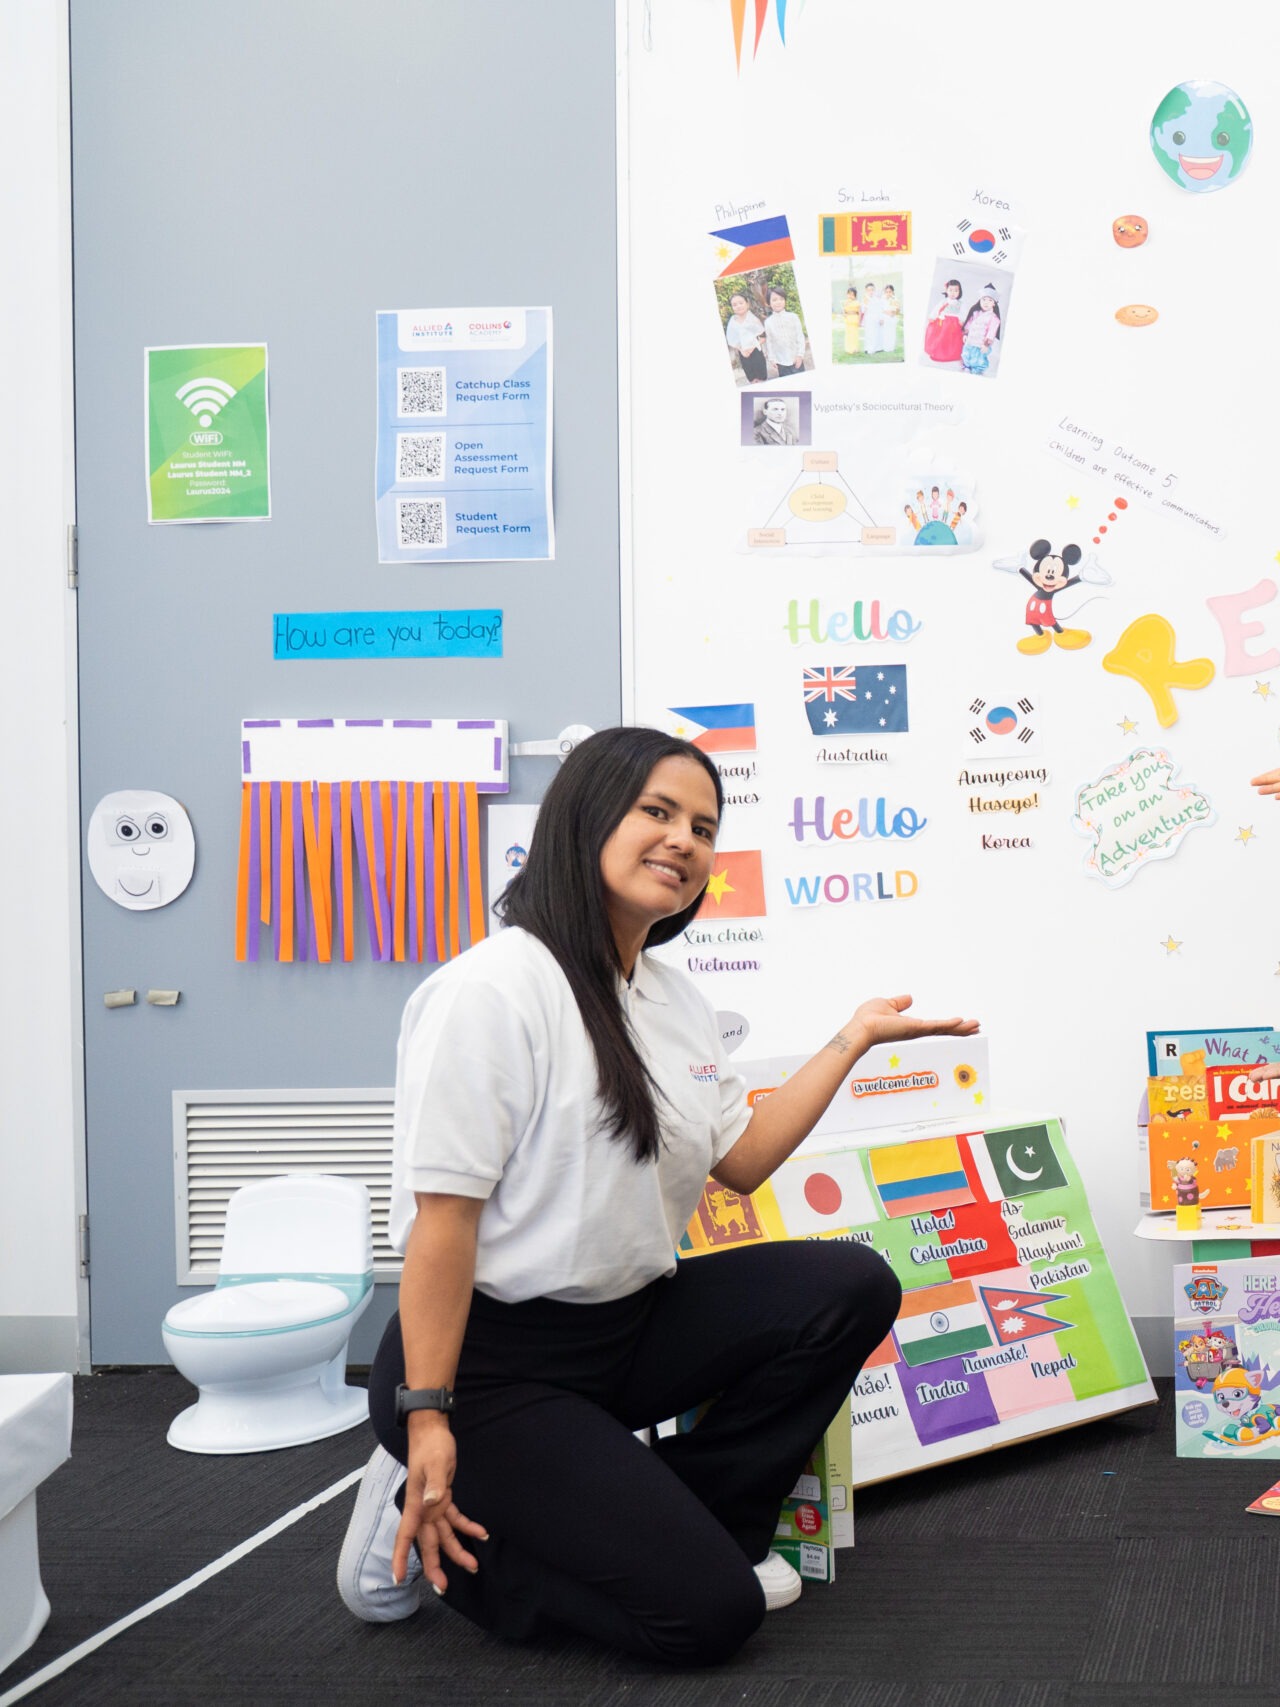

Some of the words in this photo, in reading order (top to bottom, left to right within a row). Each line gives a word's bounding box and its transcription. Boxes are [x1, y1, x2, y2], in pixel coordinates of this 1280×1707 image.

[838, 188, 856, 203] Sri
[861, 189, 891, 202] Lanka
[972, 189, 1011, 211] Korea
[413, 323, 443, 332] ALLIED
[468, 322, 502, 330] COLLINS
[455, 380, 500, 392] Catchup
[503, 378, 531, 388] Class
[456, 393, 499, 404] Request
[502, 391, 530, 400] Form
[814, 403, 860, 414] Vygotsky's
[862, 402, 922, 411] Sociocultural
[924, 402, 954, 412] Theory
[182, 450, 211, 459] Student
[454, 441, 483, 453] Open
[1058, 416, 1104, 451] Learning
[1113, 446, 1156, 475] Outcome
[1161, 473, 1178, 488] 5
[198, 460, 230, 468] Student
[454, 452, 518, 463] Assessment
[195, 470, 227, 478] Student
[454, 464, 498, 476] Request
[501, 463, 529, 474] Form
[1049, 440, 1086, 465] Children
[1092, 463, 1108, 476] are
[1113, 472, 1153, 499] effective
[1161, 499, 1220, 534] communicators
[455, 511, 498, 522] Student
[456, 524, 499, 535] Request
[502, 523, 531, 534] Form
[783, 599, 922, 645] Hello
[275, 616, 327, 653] How
[333, 626, 376, 647] are
[387, 624, 421, 651] you
[434, 615, 502, 645] today?
[816, 747, 889, 763] Australia
[958, 766, 1049, 789] Annyeong
[1083, 775, 1129, 812] Take
[1132, 759, 1167, 795] you
[969, 793, 1039, 815] Haseyo!
[1112, 808, 1136, 829] on
[1139, 791, 1164, 815] an
[787, 796, 928, 842] Hello
[982, 833, 1033, 850] Korea
[1099, 799, 1208, 871] Adventure
[785, 870, 919, 905] WORLD
[683, 929, 712, 946] Xin
[717, 927, 764, 944] chào!
[687, 957, 761, 972] Vietnam
[722, 1026, 743, 1039] and
[1166, 1043, 1177, 1056] R
[1204, 1037, 1249, 1063] What
[853, 1081, 865, 1094] is
[864, 1077, 911, 1093] welcome
[911, 1074, 936, 1089] here
[1213, 1076, 1223, 1103] I
[1001, 1201, 1023, 1217] As-
[911, 1211, 955, 1236] Hola!
[1008, 1219, 1066, 1240] Salamu-
[910, 1238, 987, 1264] Columbia
[1018, 1233, 1083, 1263] Alaykum!
[1029, 1263, 1090, 1290] Pakistan
[1243, 1275, 1277, 1293] HERE
[1184, 1282, 1229, 1300] PAW
[962, 1344, 1028, 1375] Namaste!
[1030, 1354, 1076, 1379] Nepal
[917, 1380, 969, 1404] India
